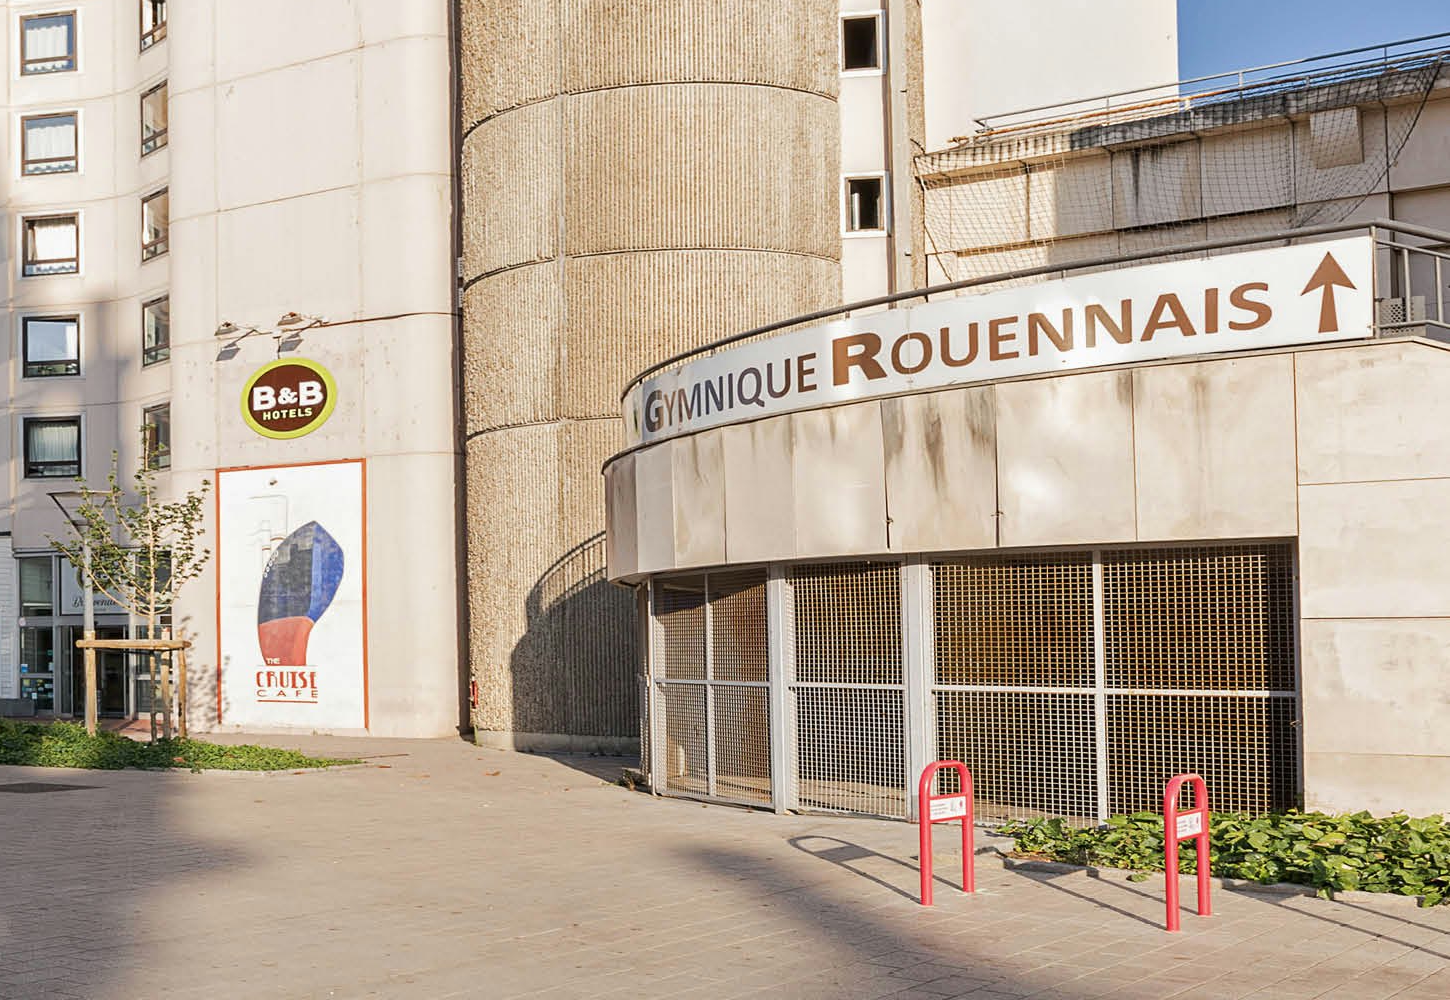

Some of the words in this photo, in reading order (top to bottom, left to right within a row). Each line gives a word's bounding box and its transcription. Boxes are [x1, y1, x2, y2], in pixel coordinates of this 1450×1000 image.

[644, 352, 818, 433] GYMNIQUE
[832, 281, 1273, 387] ROUENNAIS
[253, 381, 324, 411] B&B
[262, 407, 313, 420] HOTELS
[256, 671, 318, 689] CRUISE
[256, 689, 319, 698] CAFE
